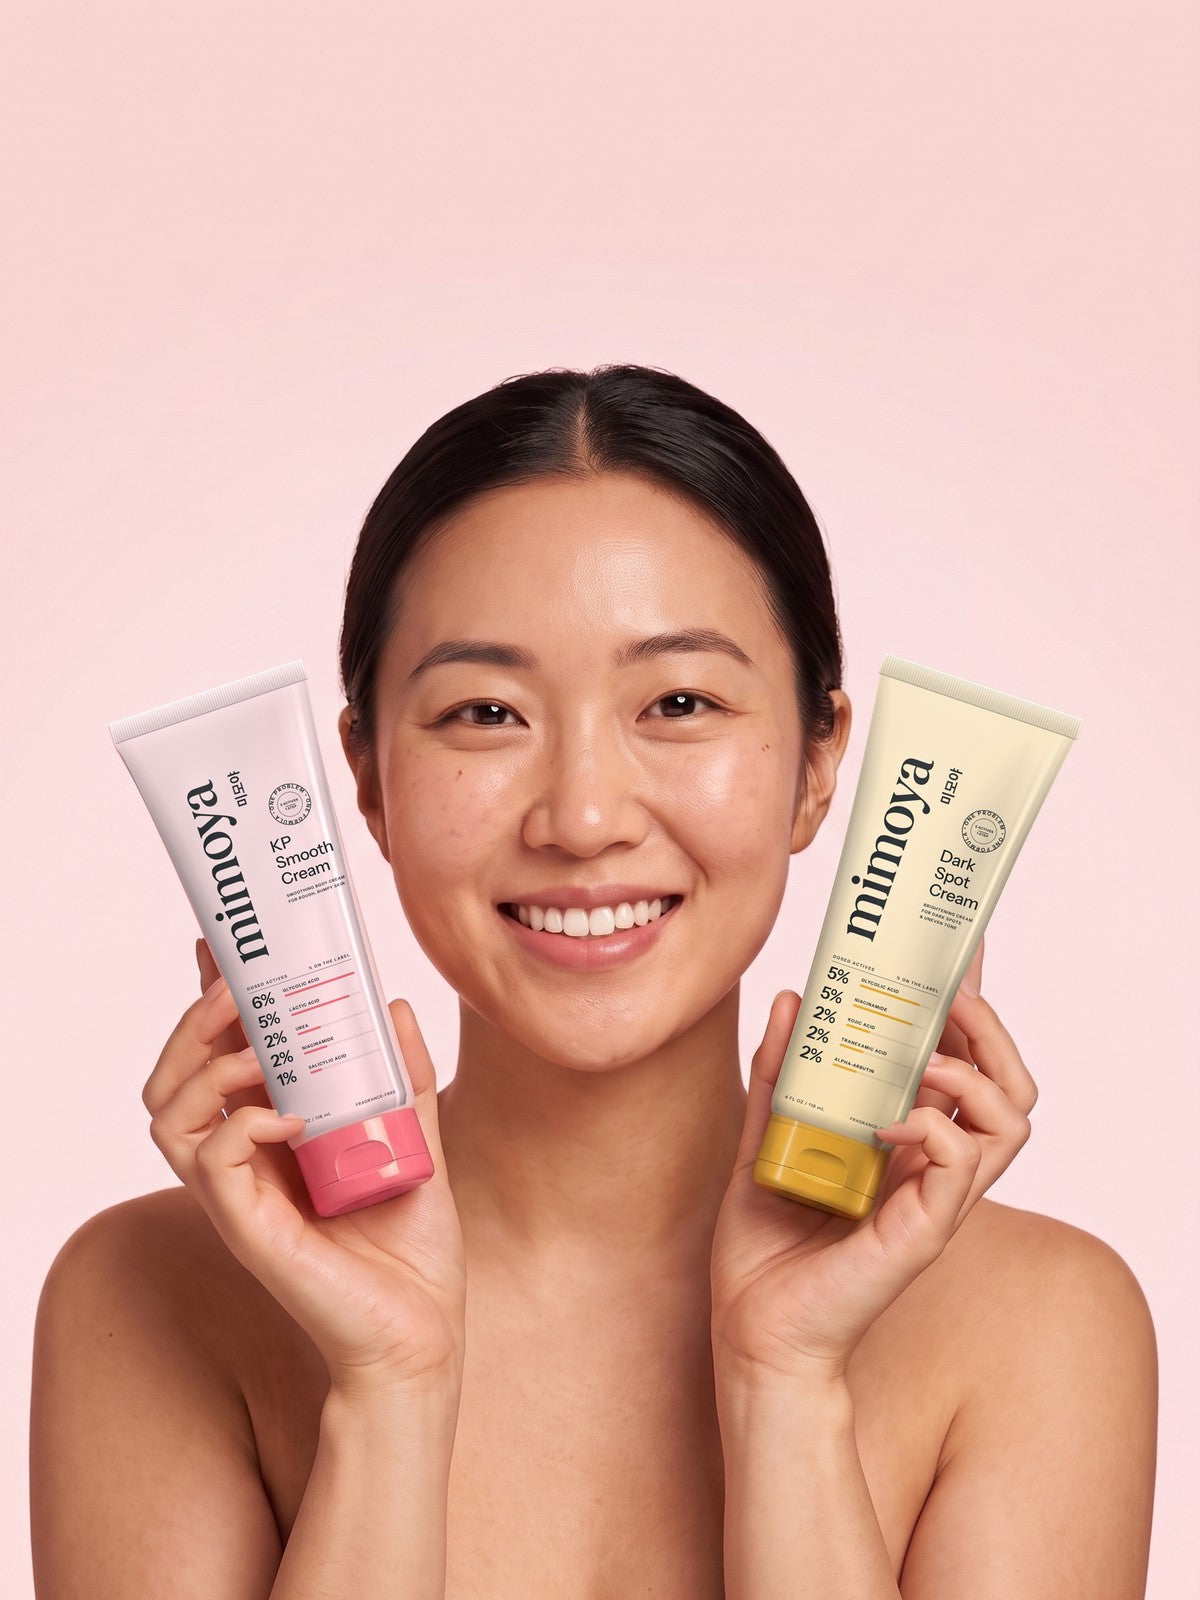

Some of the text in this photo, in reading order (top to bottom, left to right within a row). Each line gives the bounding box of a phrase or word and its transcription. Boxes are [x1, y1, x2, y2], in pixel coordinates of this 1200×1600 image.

[227, 771, 247, 807] 미모야
[273, 784, 305, 795] PROBLEM
[940, 768, 963, 804] 미모야
[275, 813, 307, 825] FORMULA
[964, 810, 1005, 830] ONE PROBLEM
[270, 836, 291, 853] KP
[847, 758, 934, 942] mimoya
[963, 832, 990, 852] FORMULA
[992, 837, 1004, 849] ONE
[276, 841, 334, 868] Smooth
[940, 849, 976, 872] Dark
[187, 779, 269, 964] mimoya
[281, 862, 331, 884] Cream
[935, 866, 971, 889] Spot
[286, 886, 314, 898] SMOOTHING
[329, 875, 345, 883] CREAM
[317, 886, 333, 894] BUMPY
[930, 884, 978, 910] Cream
[924, 903, 974, 922] BRIGHTENING CREAM
[924, 916, 943, 926] UNEVEN
[944, 922, 957, 930] TONE
[932, 912, 945, 920] DARK
[946, 917, 962, 925] SPOTS
[334, 953, 350, 962] LABEL
[832, 954, 875, 972] DOSED ACTIVES
[246, 974, 288, 991] DOSED ACTIVES
[827, 966, 900, 994] 5% GLYCOLIC ACID
[922, 984, 939, 994] LABEL
[252, 992, 275, 1010] 6%
[282, 981, 307, 993] GLYCOLIC
[820, 985, 888, 1012] 5% NIACINAMIDE
[258, 998, 320, 1029] 5% LACTIC ACID
[813, 1006, 837, 1024] 2%
[863, 1022, 876, 1030] ACID
[264, 1023, 309, 1048] 2% UREA
[806, 1026, 888, 1056] 2% TRANEXAMIC ACID
[270, 1036, 334, 1068] 2% NIACINAMIDE
[799, 1045, 875, 1074] 2% ALPHA-ARBUTIN
[276, 1070, 297, 1086] 1%
[308, 1058, 333, 1070] SALICYLIC
[355, 1090, 396, 1107] FRAGRANCE-FREE
